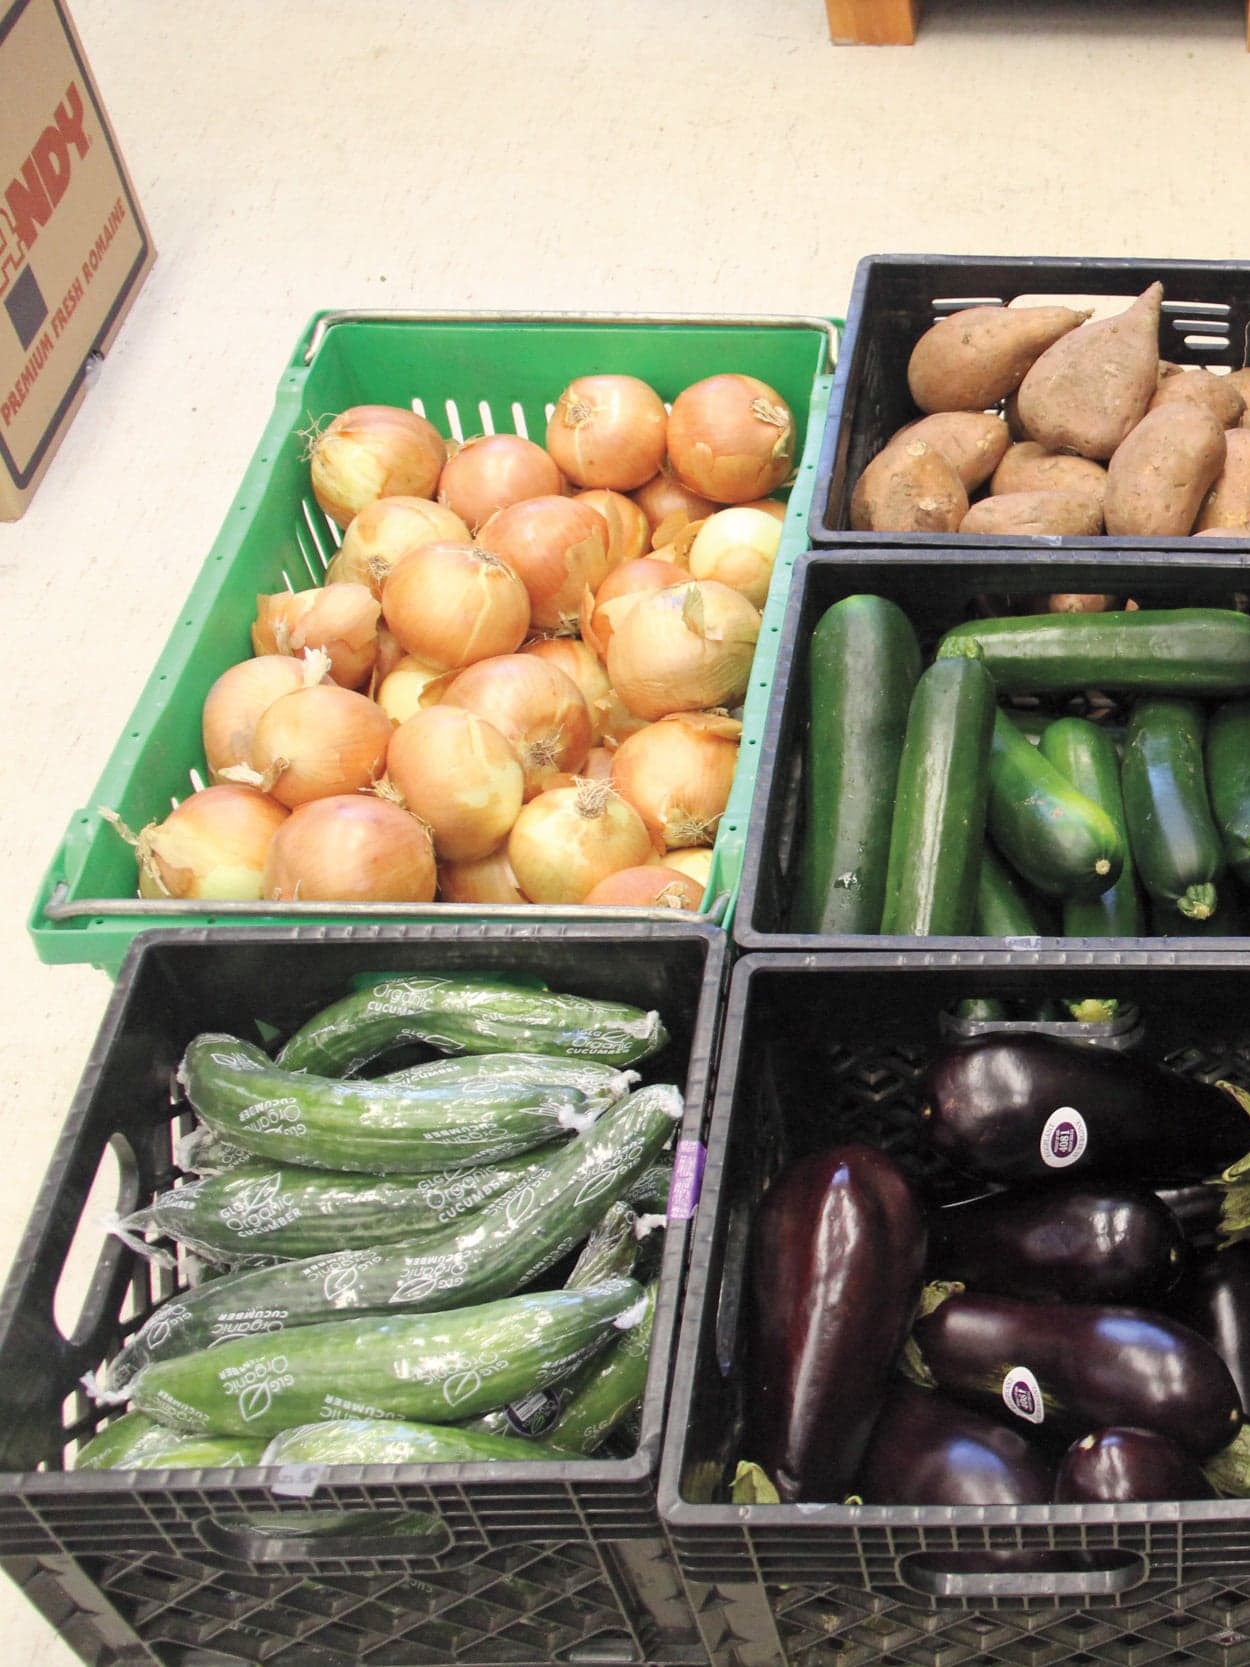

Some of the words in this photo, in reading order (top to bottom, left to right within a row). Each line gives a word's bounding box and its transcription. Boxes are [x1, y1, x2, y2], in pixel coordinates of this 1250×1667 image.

[0, 333, 54, 427] PREMIUM
[51, 275, 85, 339] FRESH
[82, 197, 126, 285] ROMAINE
[373, 983, 433, 1011] Organic
[367, 1001, 416, 1017] CUCUM
[572, 1037, 633, 1051] Organic
[239, 1097, 297, 1122] CUCUMBER
[423, 1123, 498, 1140] CUCUMBER
[1058, 1129, 1071, 1153] 4081
[417, 1174, 446, 1192] GLG
[426, 1164, 498, 1210] Organic
[219, 1200, 246, 1219] GLG
[226, 1192, 295, 1231] Organic
[237, 1207, 303, 1238] CUCUMBER
[400, 1261, 468, 1279] Organic
[438, 1276, 464, 1290] GLG
[217, 1309, 289, 1322] CUCUMBER
[210, 1318, 284, 1334] Organic
[223, 1355, 289, 1395] Organic
[478, 1359, 510, 1377] GLG
[269, 1373, 295, 1393] GLG
